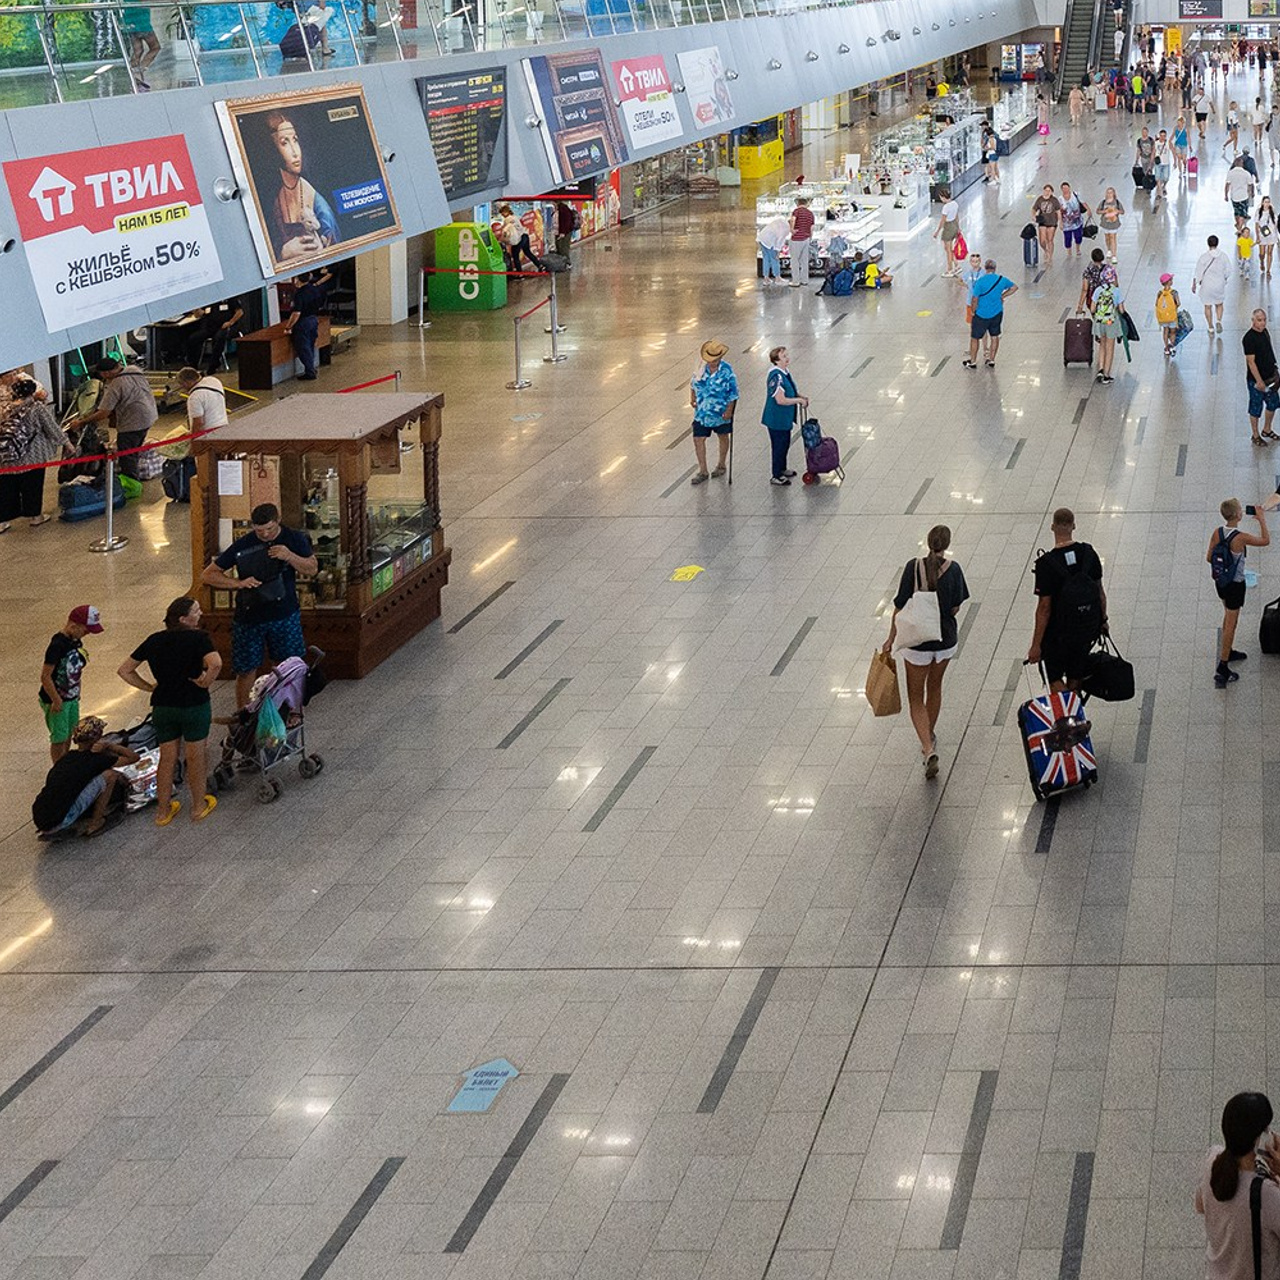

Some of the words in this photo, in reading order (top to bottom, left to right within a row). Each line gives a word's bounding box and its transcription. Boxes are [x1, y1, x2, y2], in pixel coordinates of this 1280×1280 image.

[635, 67, 666, 89] ТВИЛ
[84, 160, 186, 209] ТВИЛ
[119, 215, 148, 232] НАМ
[149, 212, 163, 225] 15
[165, 205, 188, 222] ЛЕТ
[67, 244, 132, 277] ЖИЛЬЁ
[69, 256, 156, 292] КЕШБЭКОМ
[459, 228, 480, 300] СБЕР
